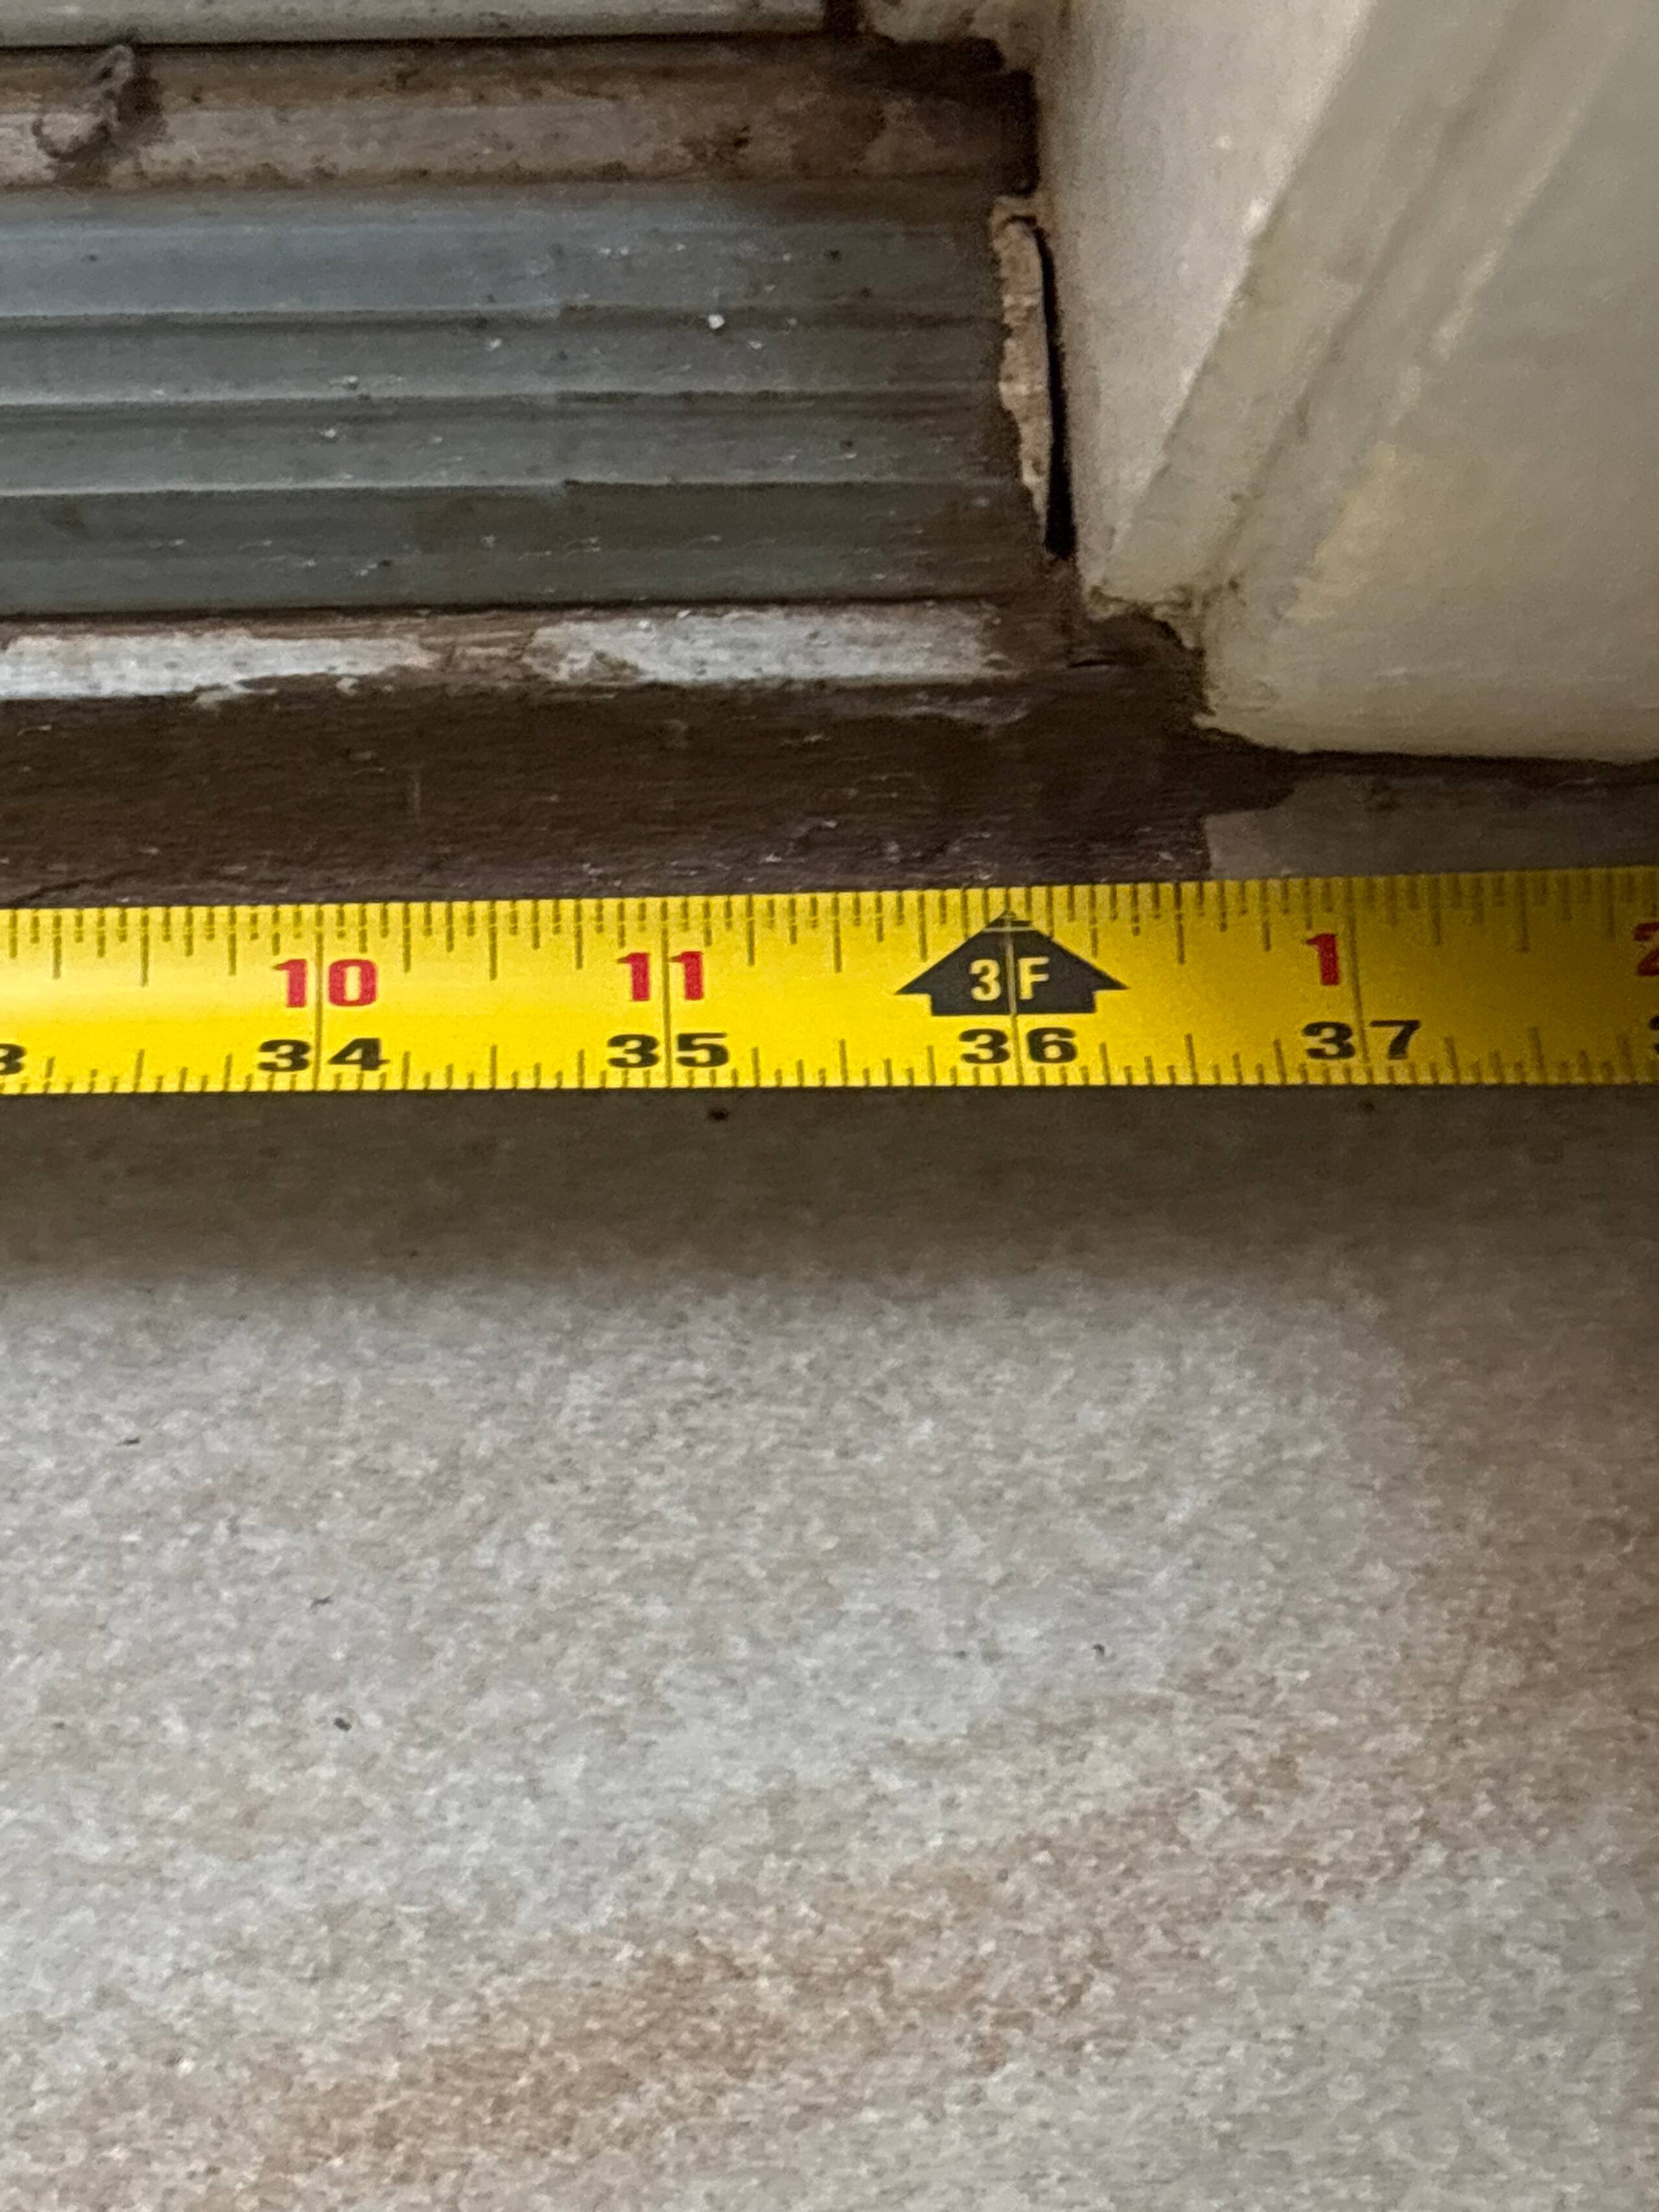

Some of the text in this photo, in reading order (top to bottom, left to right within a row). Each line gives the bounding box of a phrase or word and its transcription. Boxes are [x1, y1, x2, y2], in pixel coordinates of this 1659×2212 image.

[273, 959, 377, 1008] 10
[617, 951, 704, 1001] 11
[969, 957, 1050, 1001] 3F
[1305, 933, 1340, 986] 1
[258, 1038, 390, 1072] 34
[607, 1032, 730, 1068] 35
[959, 1027, 1077, 1064] 36
[1301, 1020, 1422, 1060] 37
